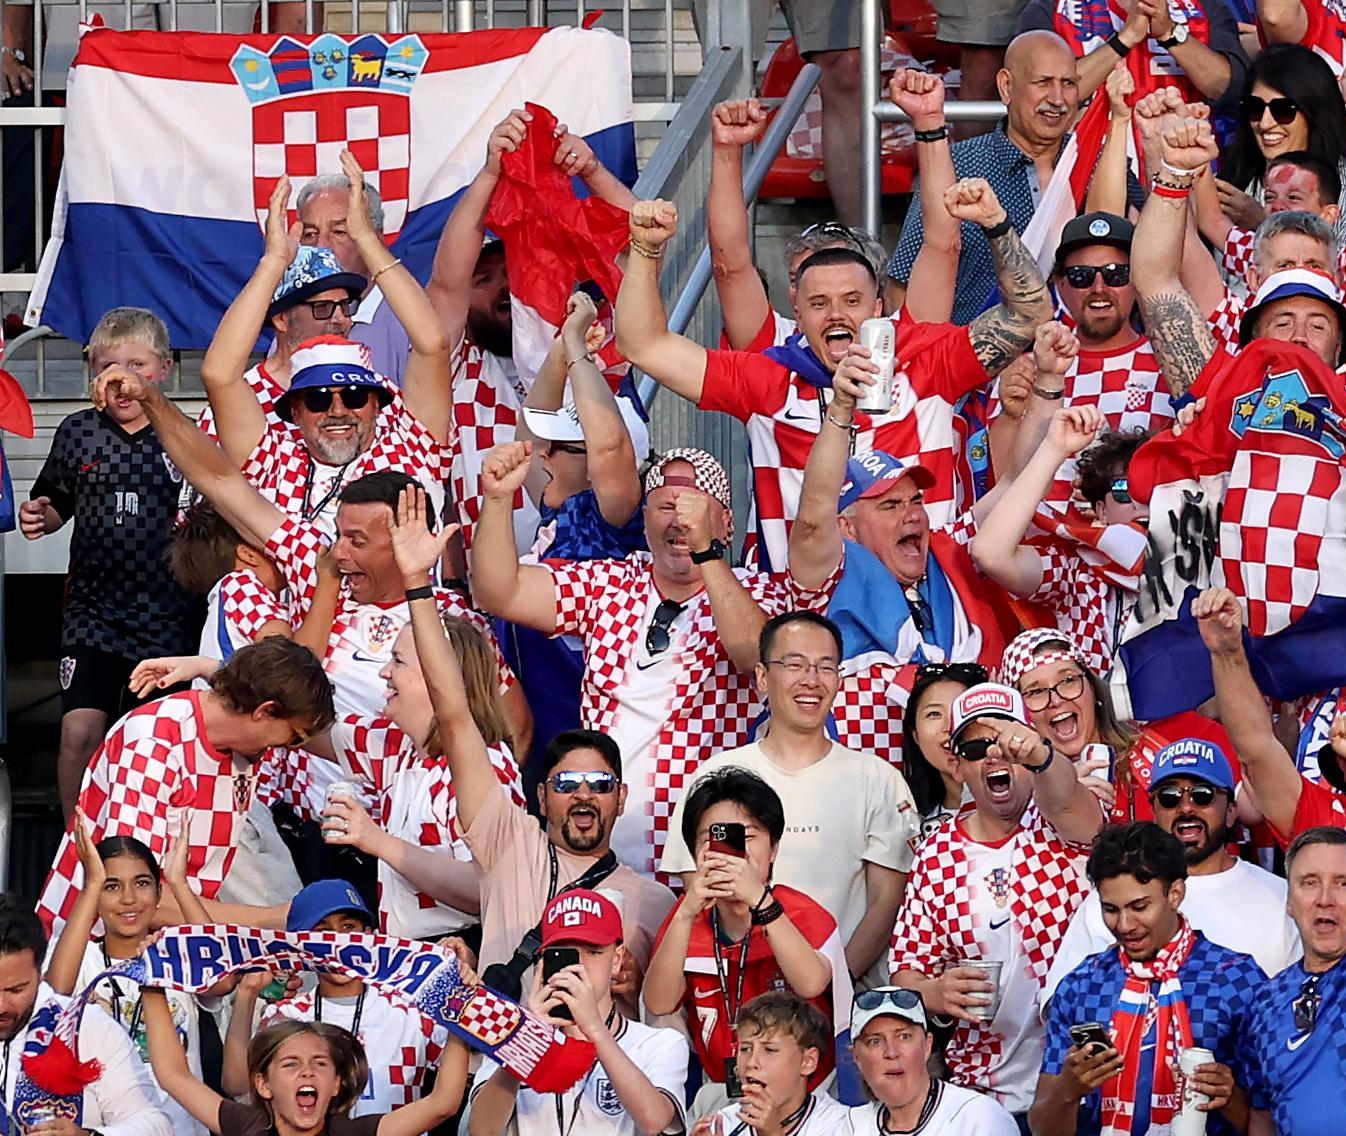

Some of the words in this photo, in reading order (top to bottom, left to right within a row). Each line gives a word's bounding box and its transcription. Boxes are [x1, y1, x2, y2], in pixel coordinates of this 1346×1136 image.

[966, 693, 1008, 709] CROATIA
[1158, 741, 1215, 774] CROATIA
[547, 896, 603, 925] CANADA
